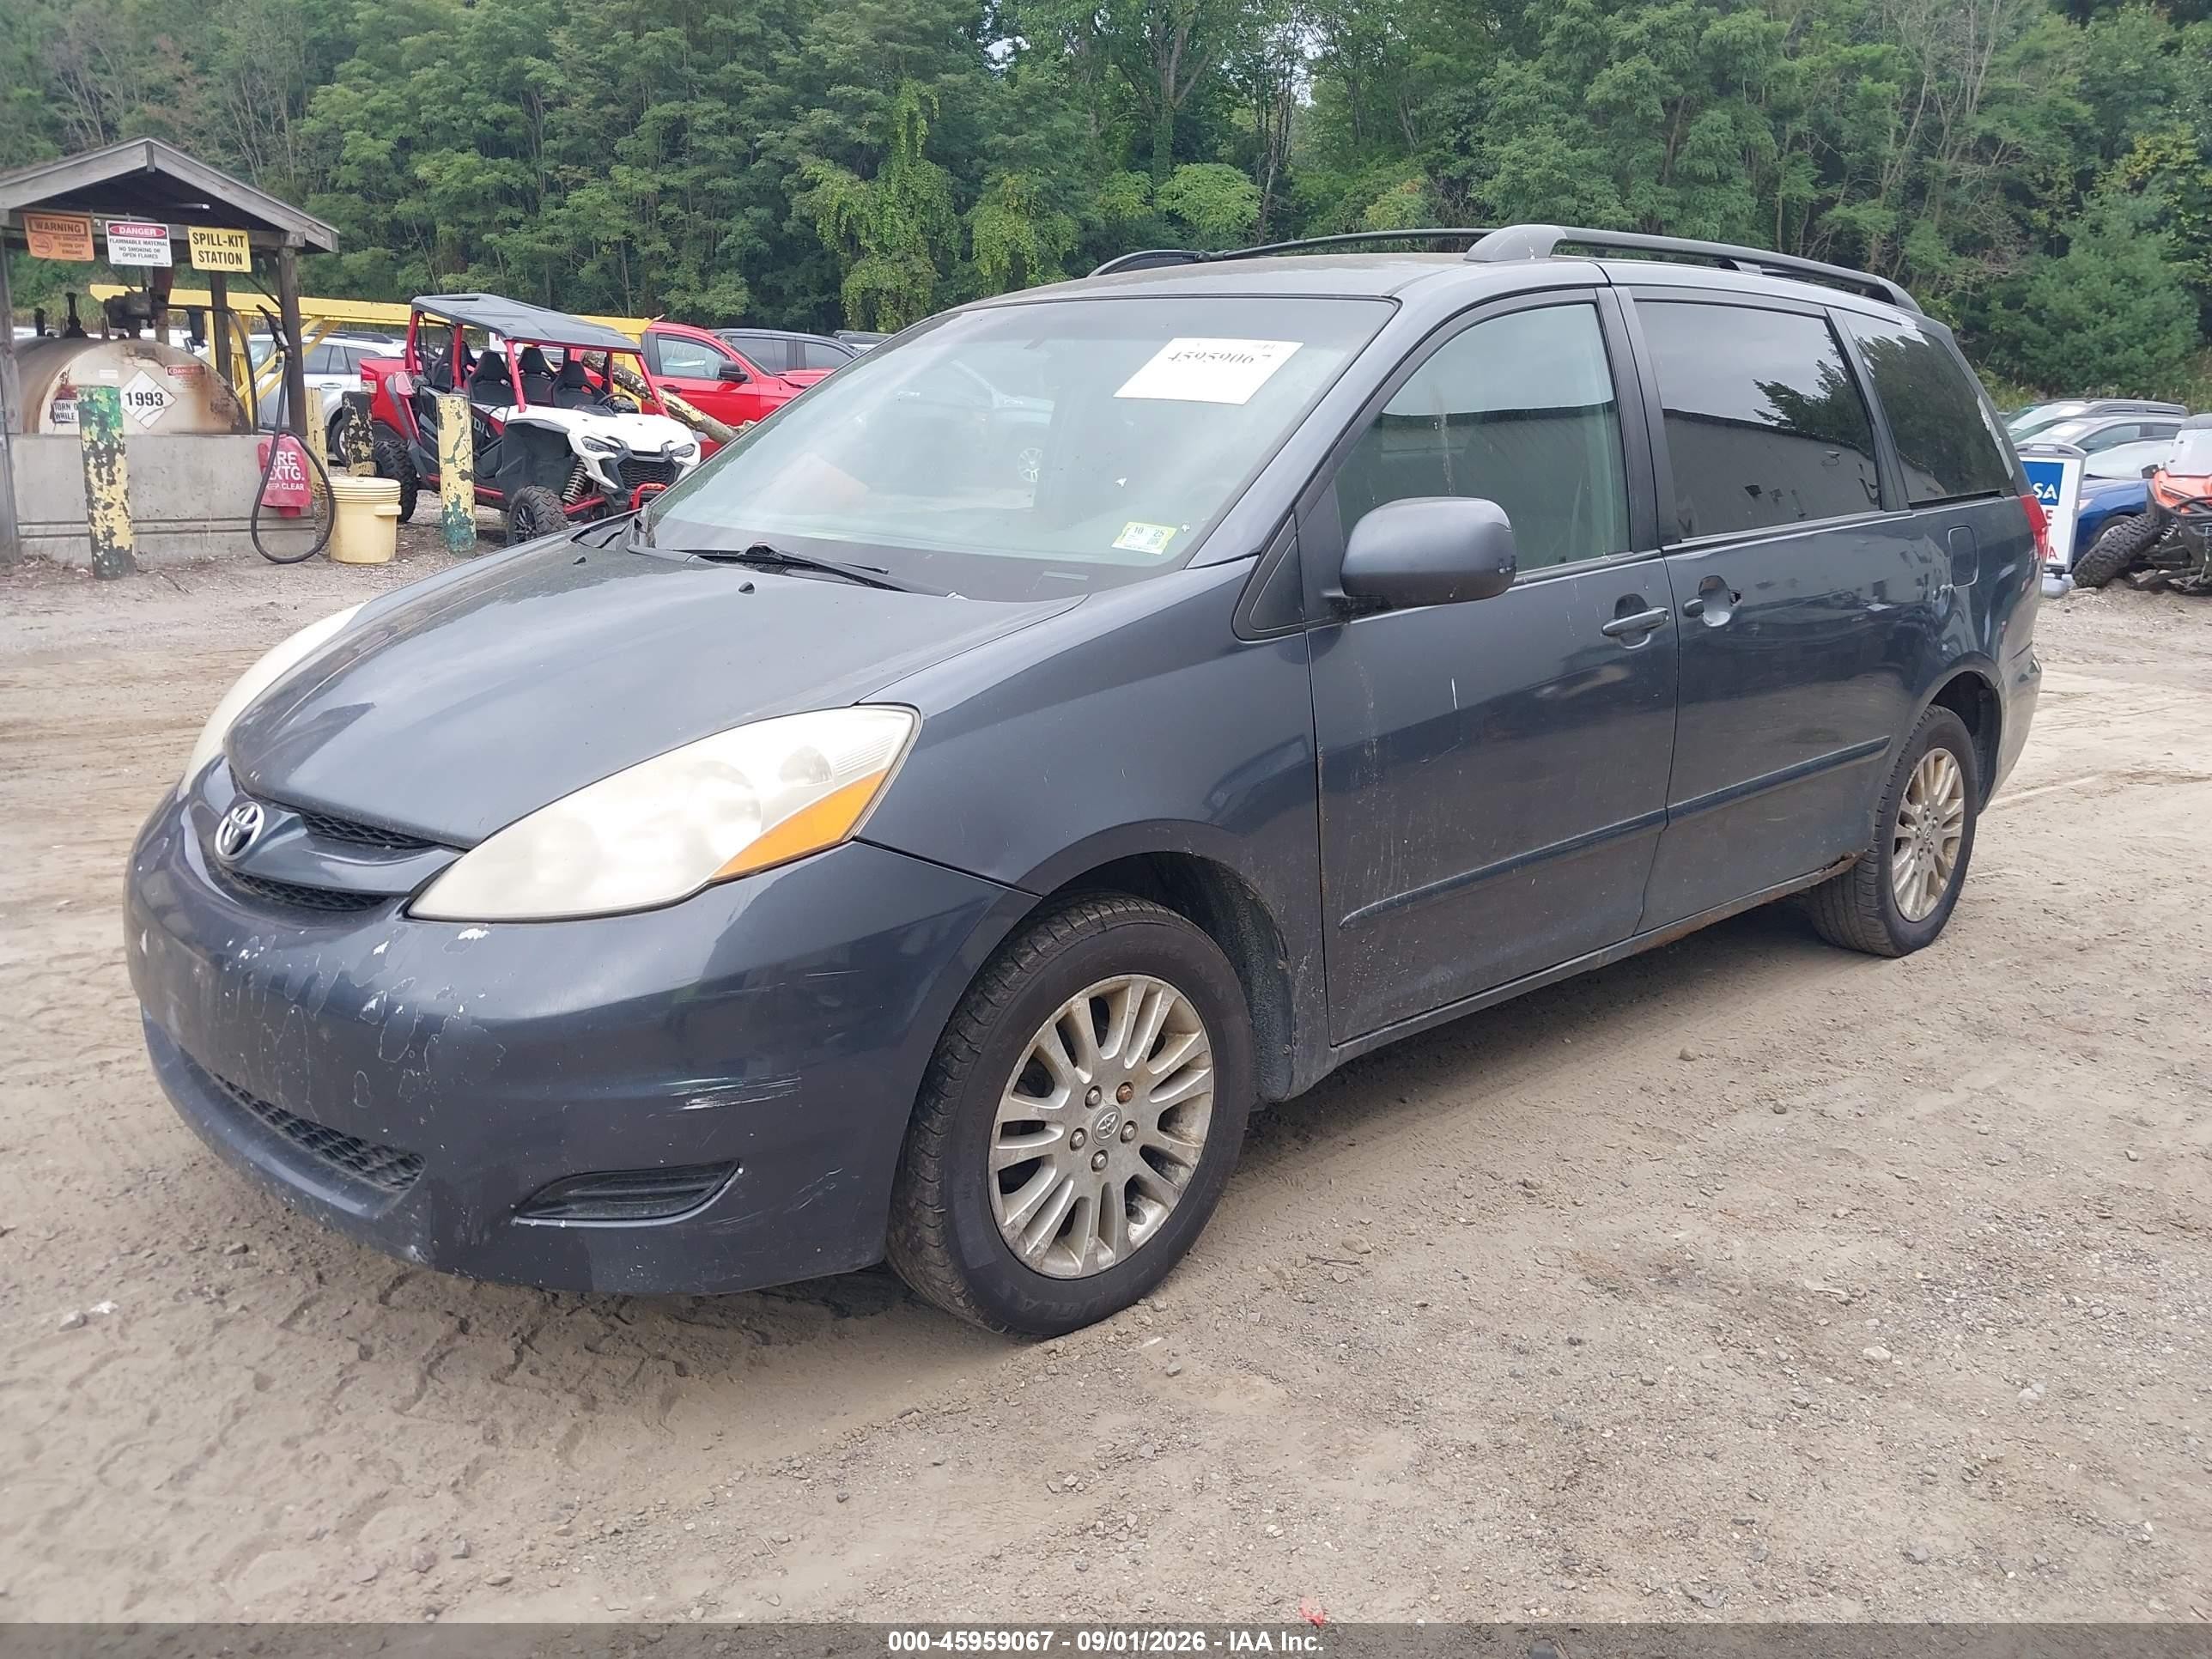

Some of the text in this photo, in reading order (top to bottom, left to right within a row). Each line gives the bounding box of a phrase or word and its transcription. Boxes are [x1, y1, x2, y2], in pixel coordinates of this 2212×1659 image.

[35, 221, 82, 234] WARNING
[118, 226, 157, 237] DANGER
[192, 232, 245, 248] SPILL-KIT
[198, 250, 243, 265] STATION
[125, 392, 164, 406] 1993
[53, 402, 70, 411] TURN
[55, 412, 76, 421] WHILE
[281, 483, 305, 491] CLEAR
[1153, 529, 1164, 538] 25
